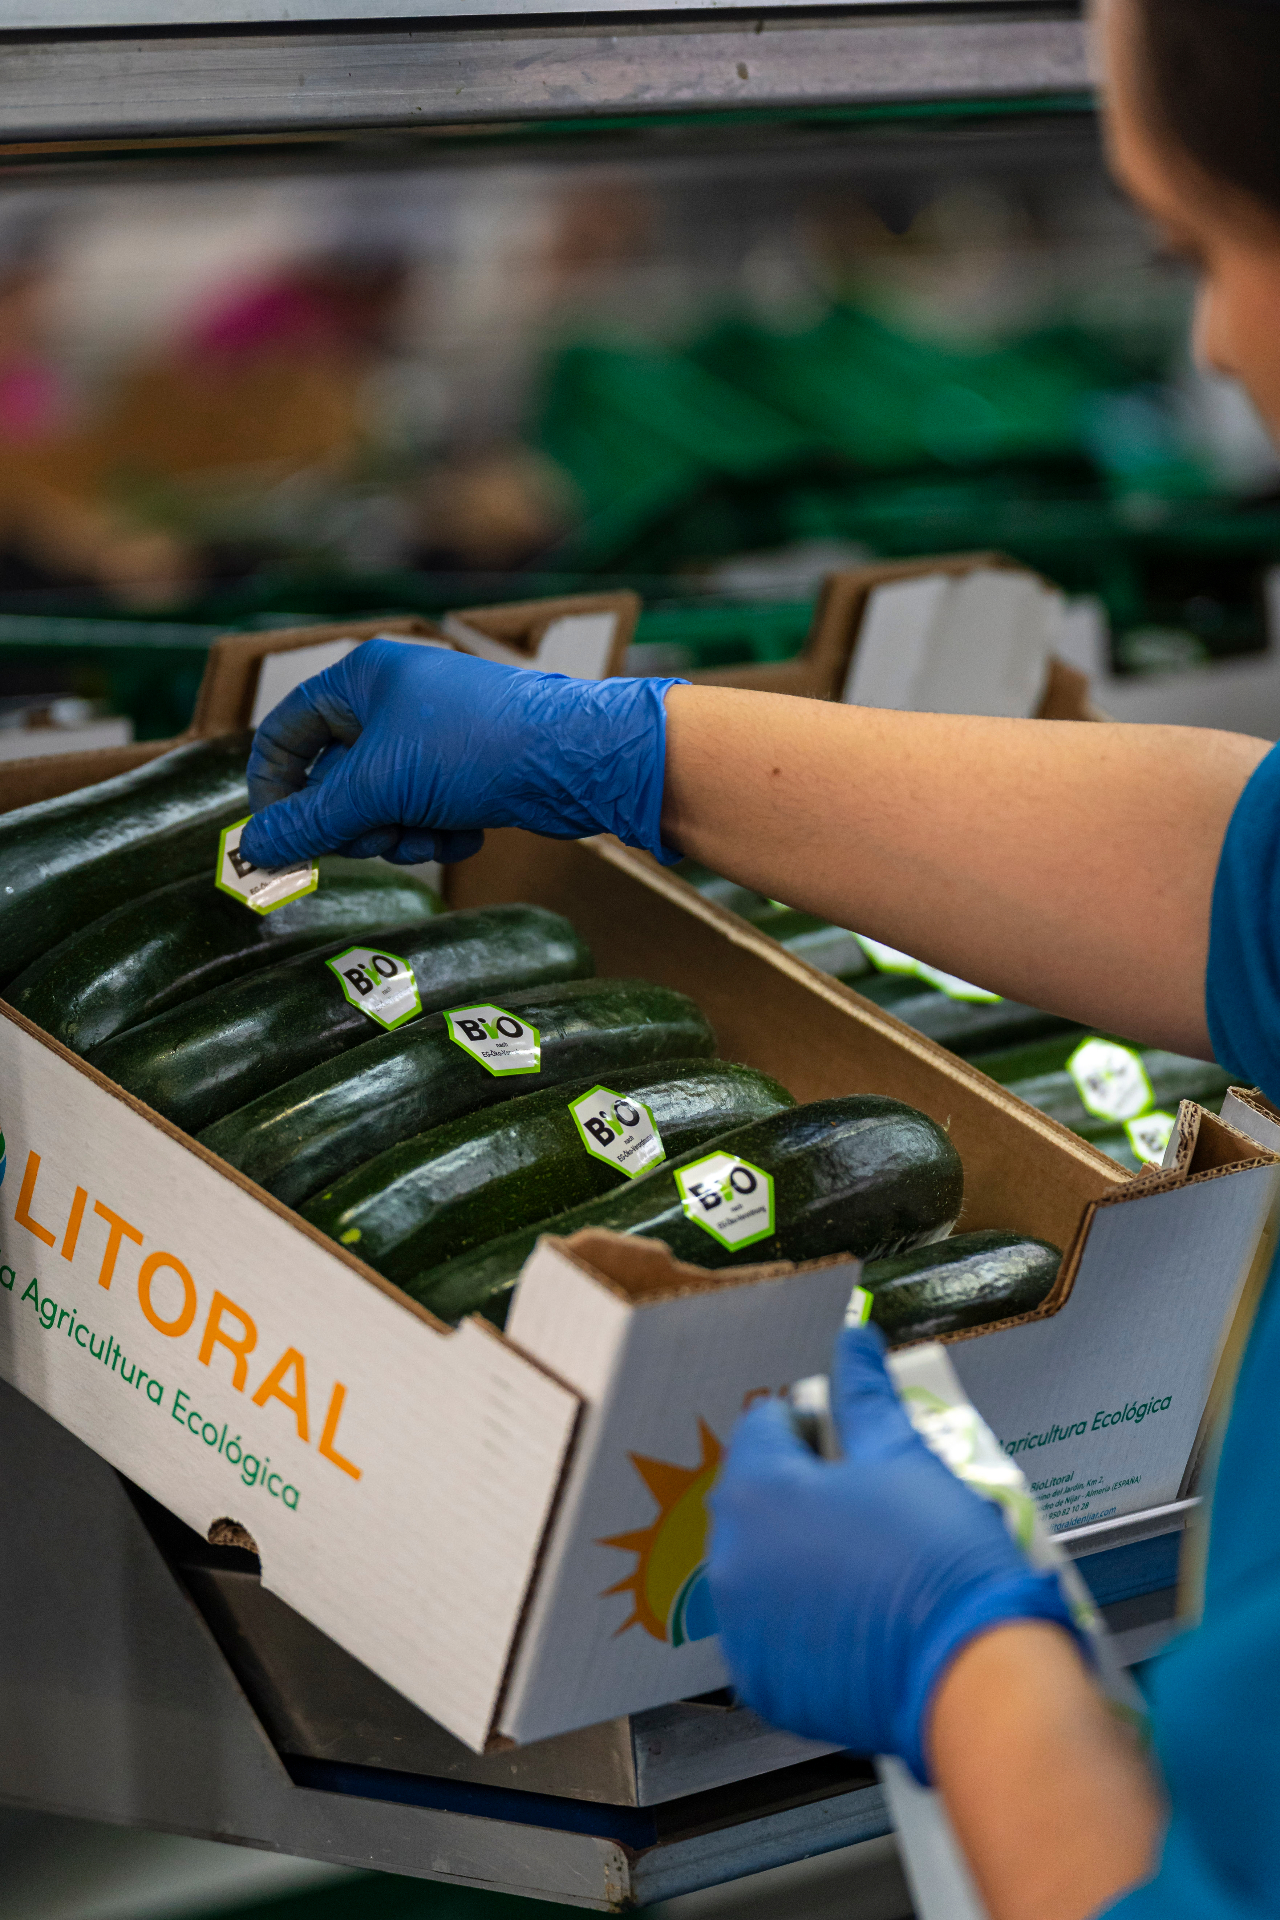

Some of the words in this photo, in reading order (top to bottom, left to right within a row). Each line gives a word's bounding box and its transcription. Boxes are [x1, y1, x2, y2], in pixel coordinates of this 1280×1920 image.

[623, 1135, 635, 1145] nach
[14, 1150, 364, 1482] LITORAL
[21, 1277, 164, 1406] Agricultura
[171, 1387, 301, 1512] Ecológica
[1091, 1395, 1173, 1431] Ecológica
[1072, 1504, 1080, 1514] 10
